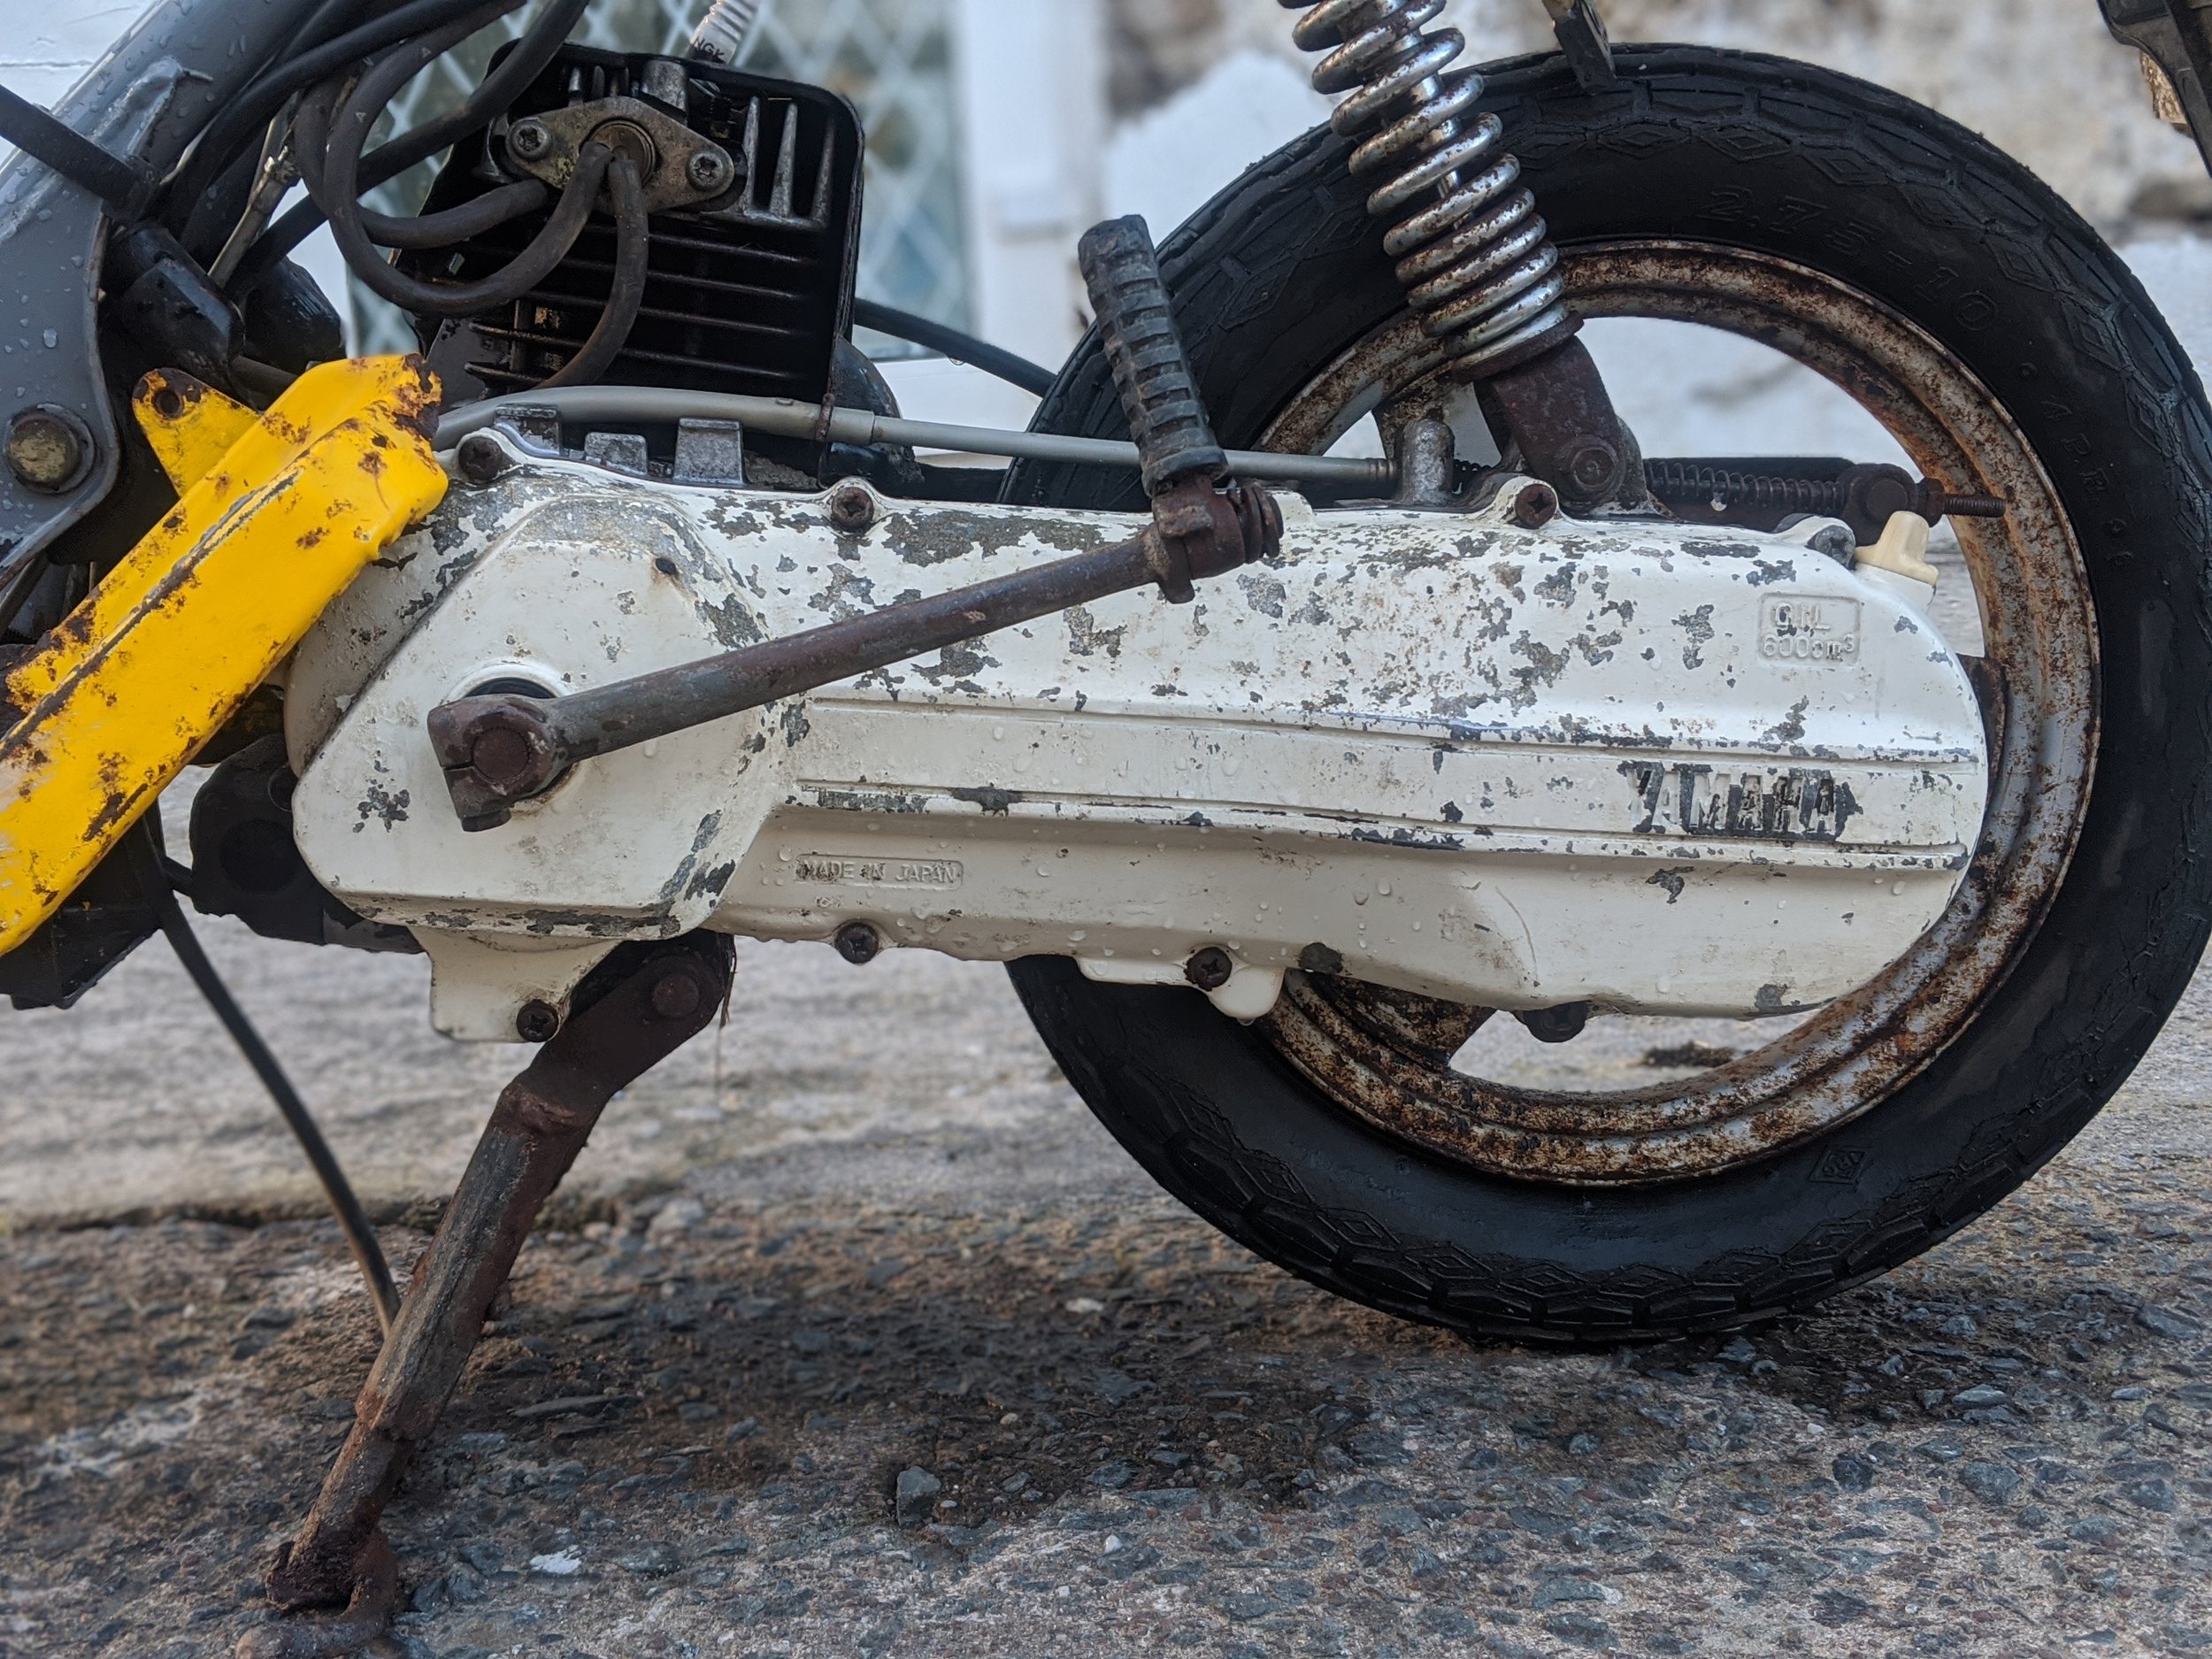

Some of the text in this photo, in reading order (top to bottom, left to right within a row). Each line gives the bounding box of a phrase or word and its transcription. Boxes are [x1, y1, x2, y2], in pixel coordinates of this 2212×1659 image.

[690, 36, 726, 64] NGK
[1696, 183, 1998, 331] 2.75-10
[1624, 767, 1838, 833] YAMAHA
[797, 859, 956, 884] MADE IN JAPAN
